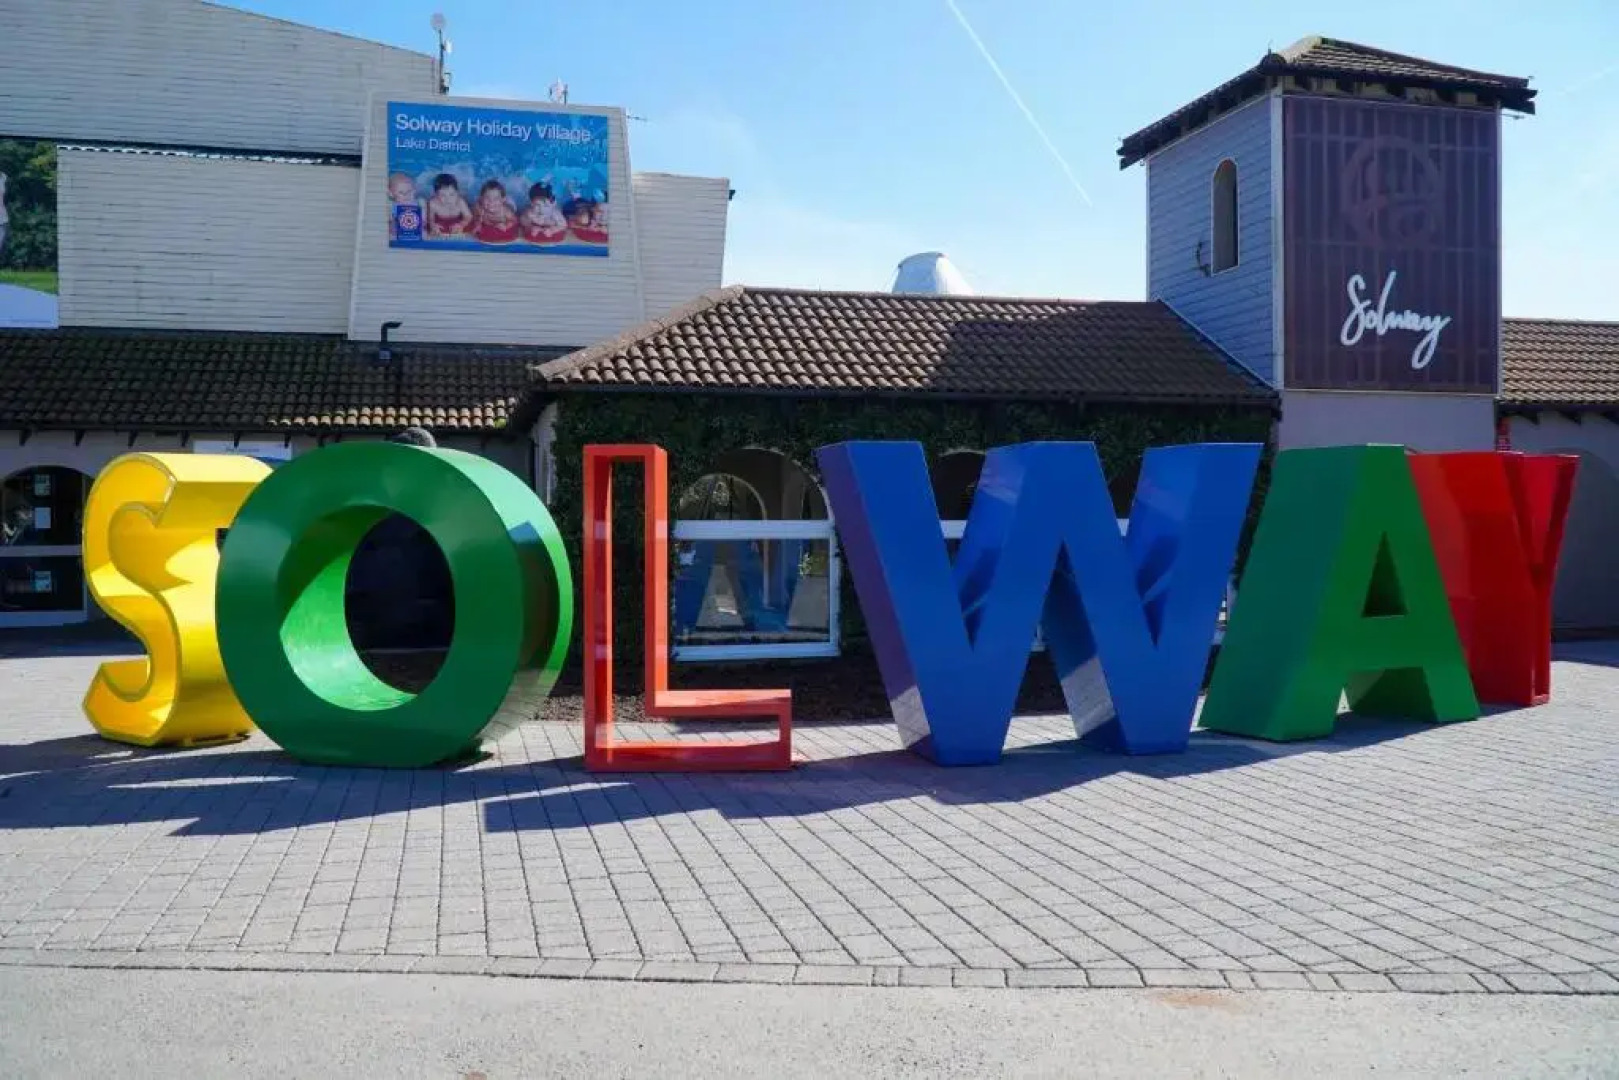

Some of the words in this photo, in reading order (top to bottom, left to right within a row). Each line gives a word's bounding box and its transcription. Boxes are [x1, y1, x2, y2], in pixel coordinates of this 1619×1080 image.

[396, 113, 463, 136] Solway
[467, 118, 531, 141] Holiday
[535, 122, 591, 144] Village
[396, 137, 426, 149] Lake
[429, 138, 470, 152] District
[1341, 271, 1451, 369] Solway
[82, 441, 1579, 771] SOLWAY
